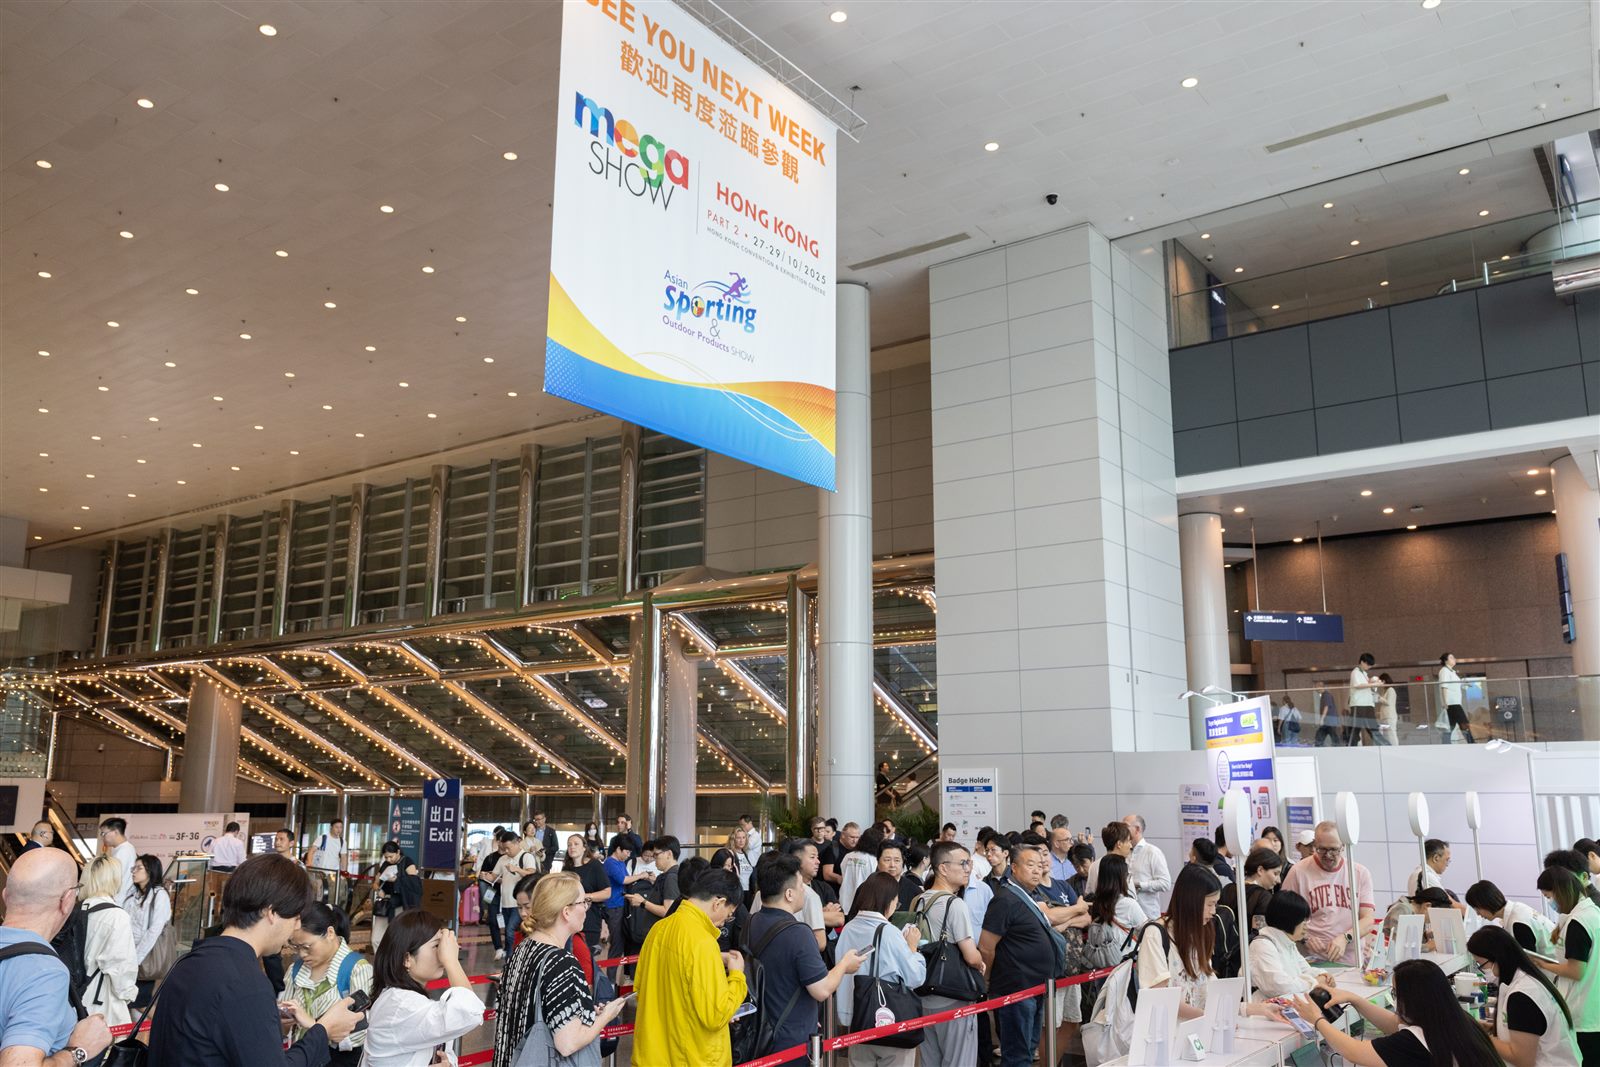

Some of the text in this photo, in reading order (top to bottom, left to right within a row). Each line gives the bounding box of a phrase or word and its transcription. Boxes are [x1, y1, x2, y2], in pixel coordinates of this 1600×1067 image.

[586, 0, 826, 166] EE YOU NEXT WEEK
[620, 40, 800, 184] 歡迎再度蒞臨參觀
[574, 91, 689, 190] mega
[588, 140, 675, 211] SHOW
[707, 209, 730, 230] PART
[734, 224, 740, 236] 2
[716, 182, 820, 259] HONG KONG
[664, 269, 689, 290] Asian
[707, 226, 723, 240] HONG
[724, 236, 740, 249] KONG
[741, 245, 775, 267] CONVENTION
[780, 266, 808, 286] EXHIBITION
[663, 284, 757, 334] Sporting
[709, 318, 721, 339] &
[662, 315, 755, 363] Outdoor Products SHOW
[948, 776, 991, 785] Badge Holder
[429, 827, 454, 842] Exit
[430, 805, 454, 823] 出口
[1308, 884, 1333, 914] LIVE
